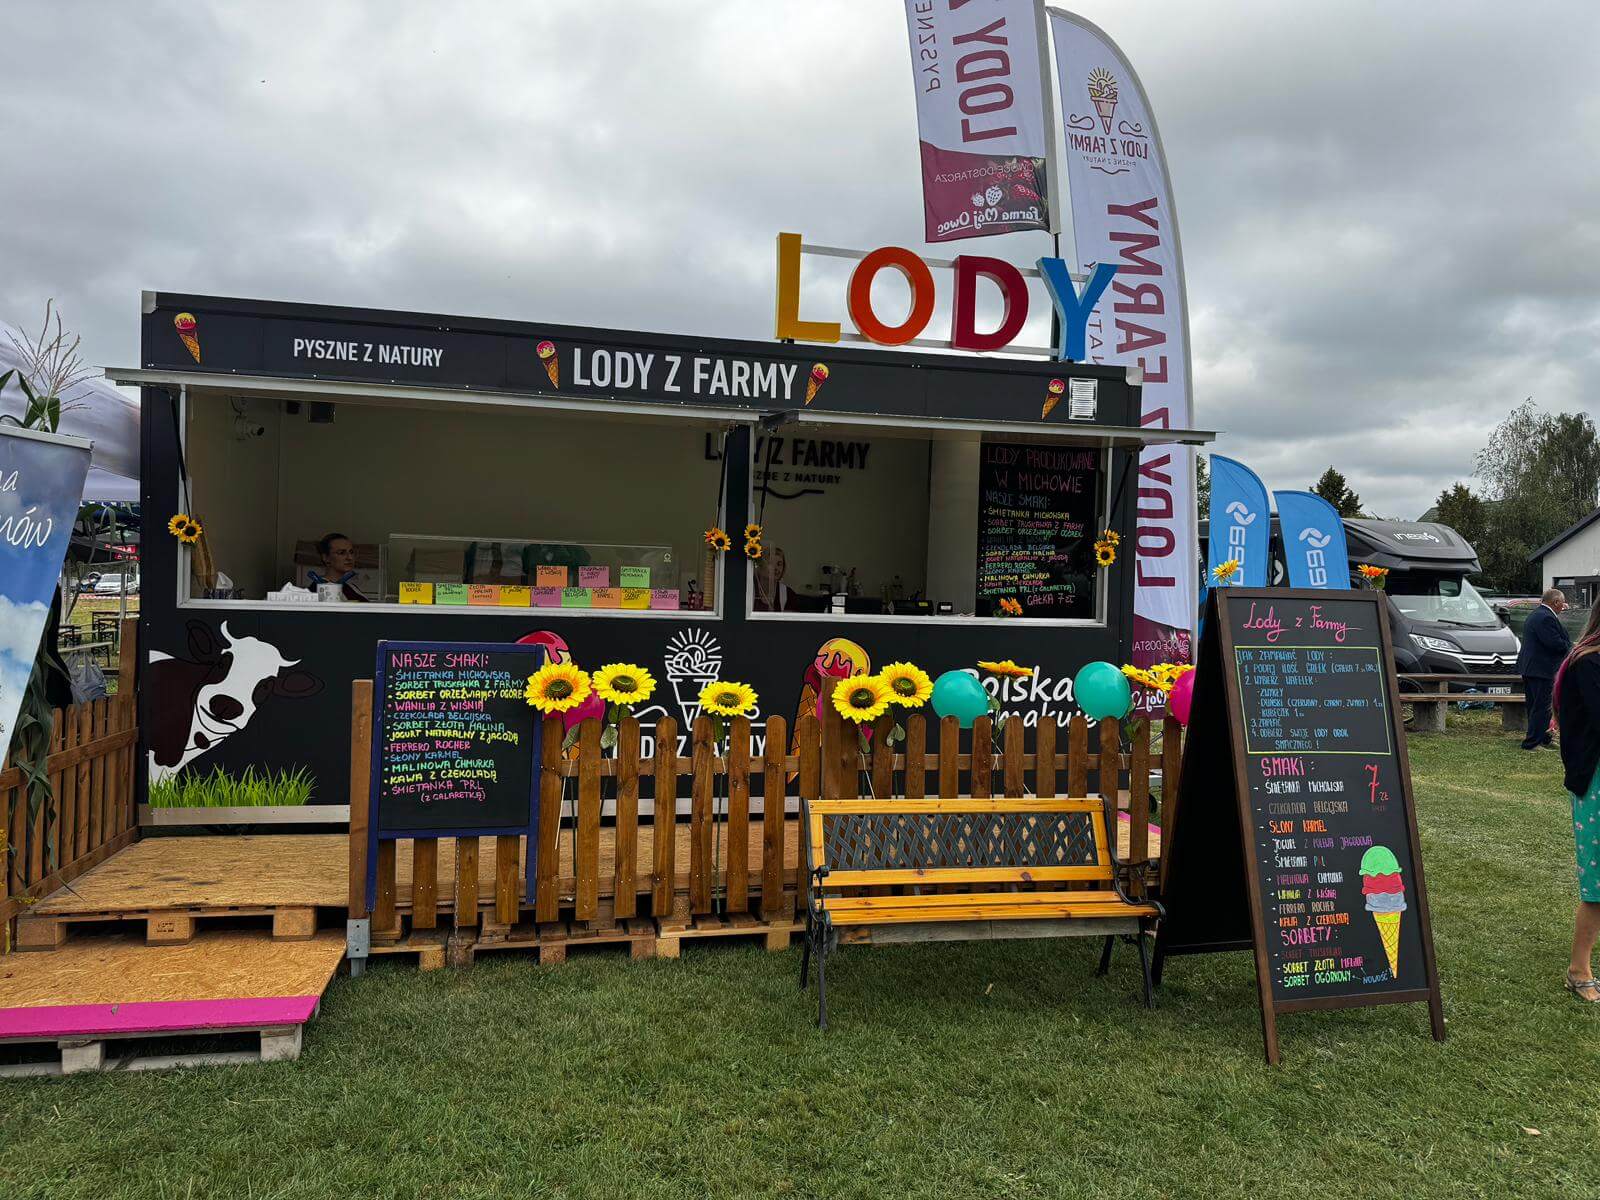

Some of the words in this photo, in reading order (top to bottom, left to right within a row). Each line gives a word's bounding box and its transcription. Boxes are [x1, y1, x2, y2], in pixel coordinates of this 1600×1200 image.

[776, 232, 1120, 362] LODY
[294, 337, 358, 361] PYSZNE
[363, 344, 373, 362] Z
[378, 345, 443, 367] NATURY
[573, 347, 654, 390] LODY
[664, 355, 681, 392] Z
[693, 357, 798, 400] FARMY
[791, 438, 870, 470] FARMY
[795, 473, 841, 484] NATURY
[1018, 471, 1083, 494] MICHOWIE
[1243, 602, 1290, 642] Lody
[1310, 605, 1363, 642] Farmy
[392, 653, 437, 668] NASZE
[443, 653, 489, 668] SMAKI:
[395, 669, 453, 680] ŚMIETANKA
[458, 670, 511, 680] MICHOWSKA
[395, 680, 430, 690] SORBET
[433, 680, 480, 689] TRUSKAWKA
[484, 680, 490, 689] Z
[494, 679, 525, 689] FARMY
[395, 690, 436, 700] SORBET
[395, 701, 436, 711] WANILIA
[440, 701, 447, 710] Z
[450, 699, 484, 712] WIŚNIĄ
[393, 711, 445, 720] CZEKOLADA
[448, 711, 492, 722] BELGIJSKA
[393, 720, 429, 731] SORBET
[434, 720, 465, 730] ZŁOTA
[469, 721, 505, 733] MALINA
[389, 729, 422, 741] JOGURT
[425, 729, 475, 739] NATURALNY
[480, 732, 486, 741] Z
[390, 742, 430, 752] FERRERO
[435, 740, 471, 750] ROCHER
[425, 750, 463, 760] KARMEL
[392, 760, 450, 773] MALINOWA
[455, 758, 495, 769] CHMURKA
[390, 772, 423, 785] KAWA
[430, 771, 437, 780] Z
[1364, 764, 1380, 803] 7
[391, 780, 454, 795] ŚMIETANKA
[460, 779, 484, 790] PRL
[1282, 960, 1309, 974] SORBET
[1283, 974, 1310, 988] SORBET
